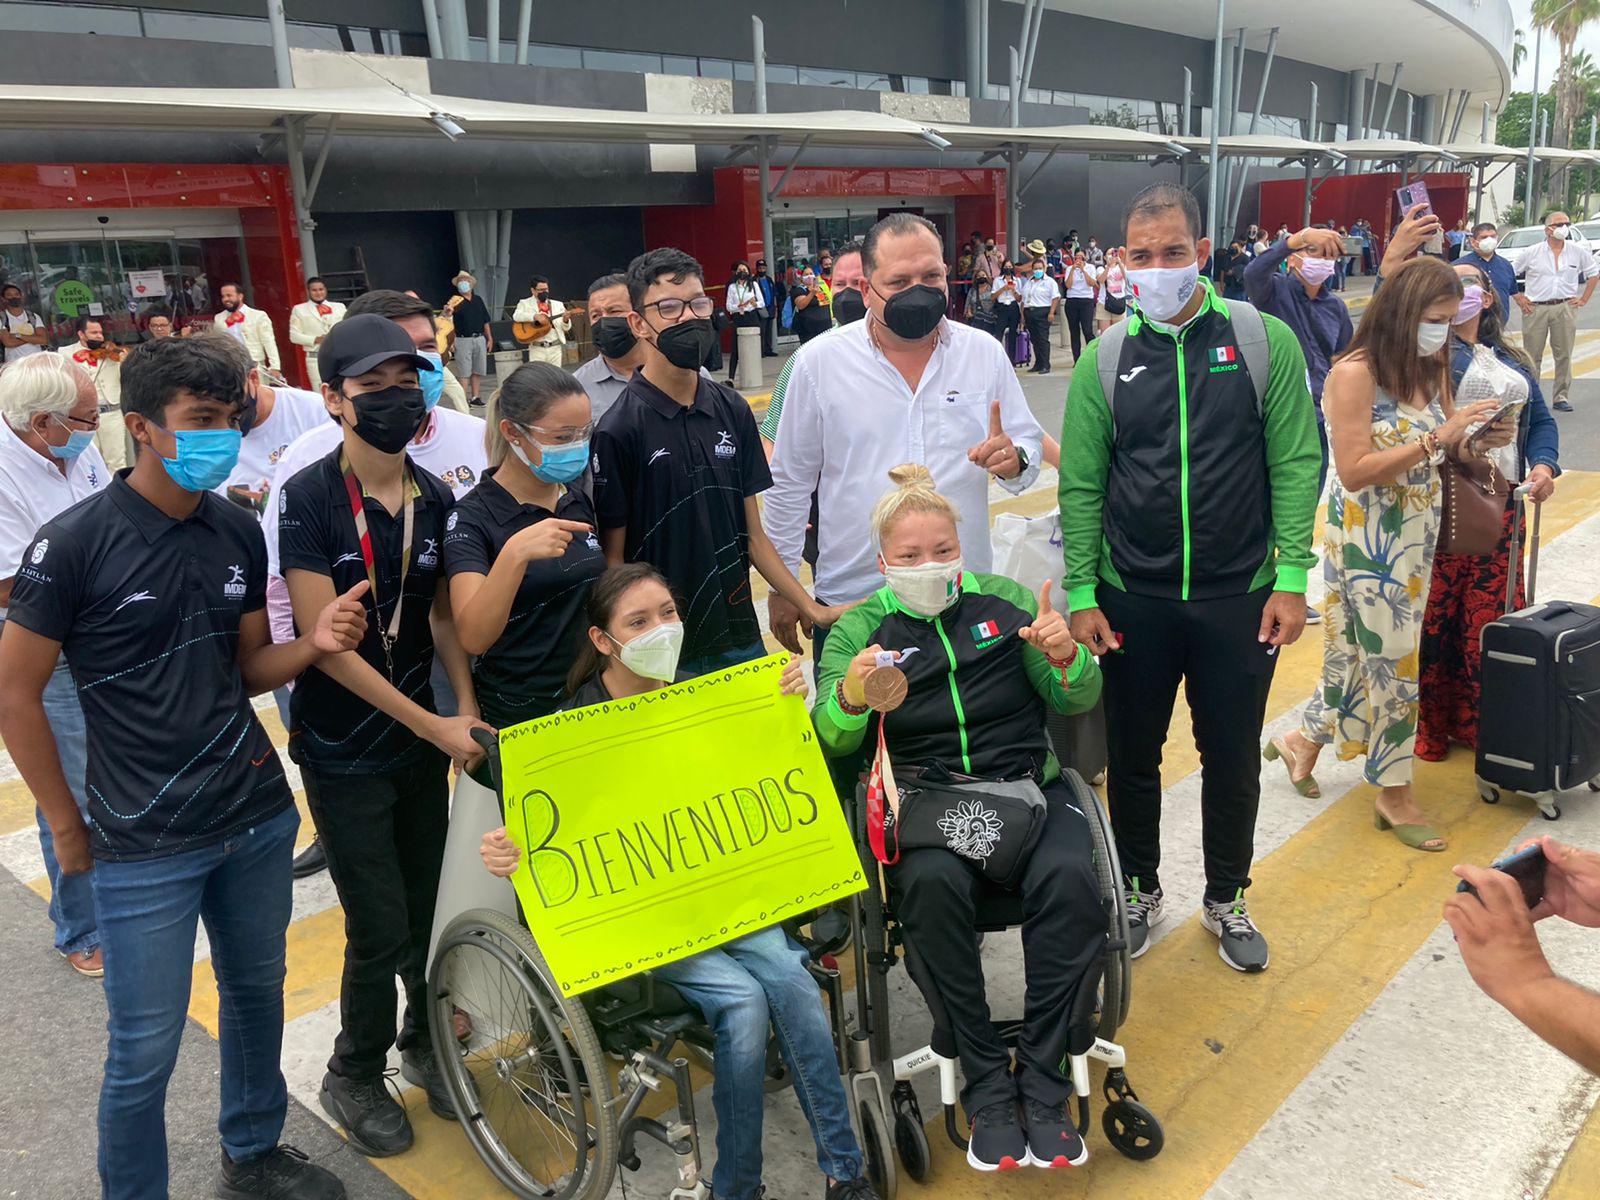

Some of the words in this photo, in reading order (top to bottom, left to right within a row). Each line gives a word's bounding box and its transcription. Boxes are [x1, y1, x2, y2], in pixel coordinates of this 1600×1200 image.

[62, 287, 83, 297] Safe
[59, 293, 91, 305] travels
[1209, 363, 1239, 374] MÉXICO
[906, 1052, 932, 1069] QUICKIE
